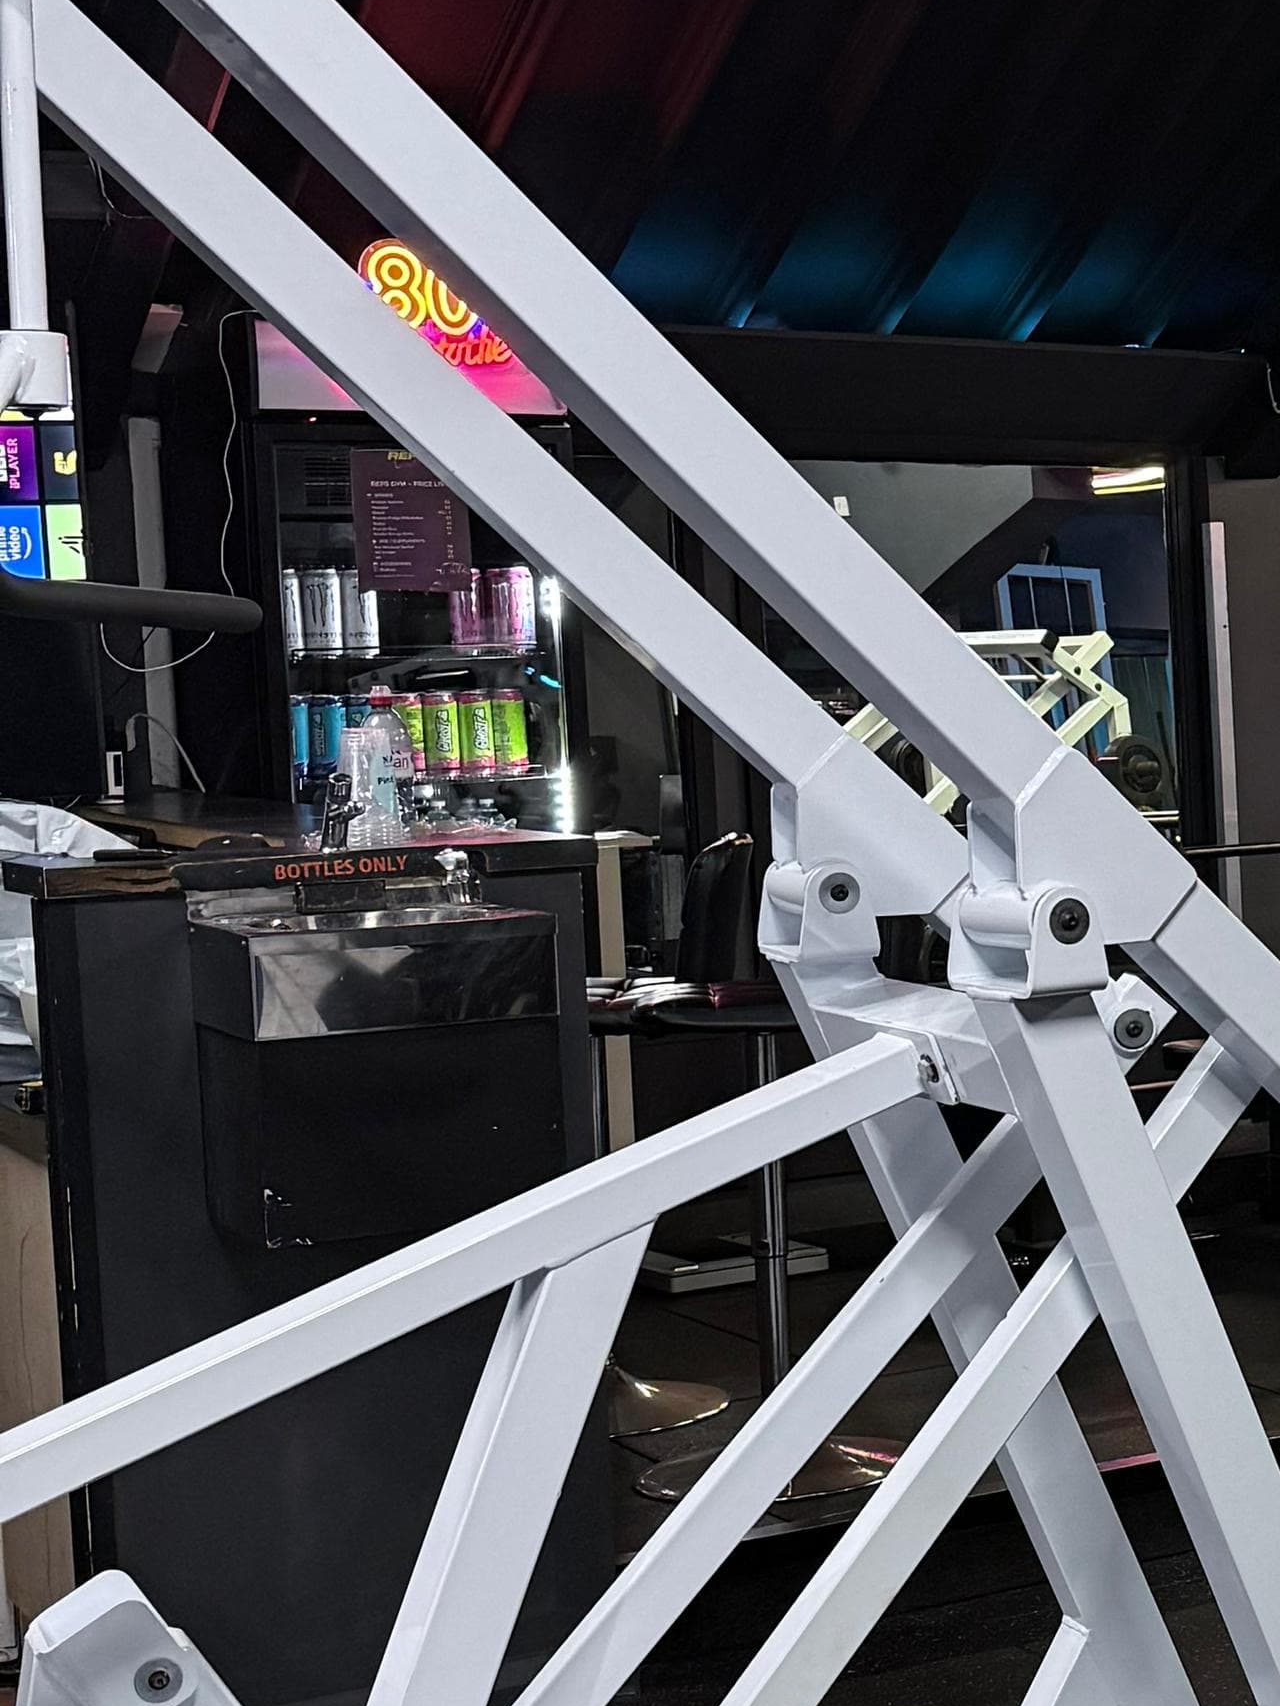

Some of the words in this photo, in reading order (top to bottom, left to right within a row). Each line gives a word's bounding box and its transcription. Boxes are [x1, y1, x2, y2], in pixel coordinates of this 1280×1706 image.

[7, 526, 22, 561] video
[274, 858, 355, 881] BOTTLES
[358, 854, 408, 873] ONLY
